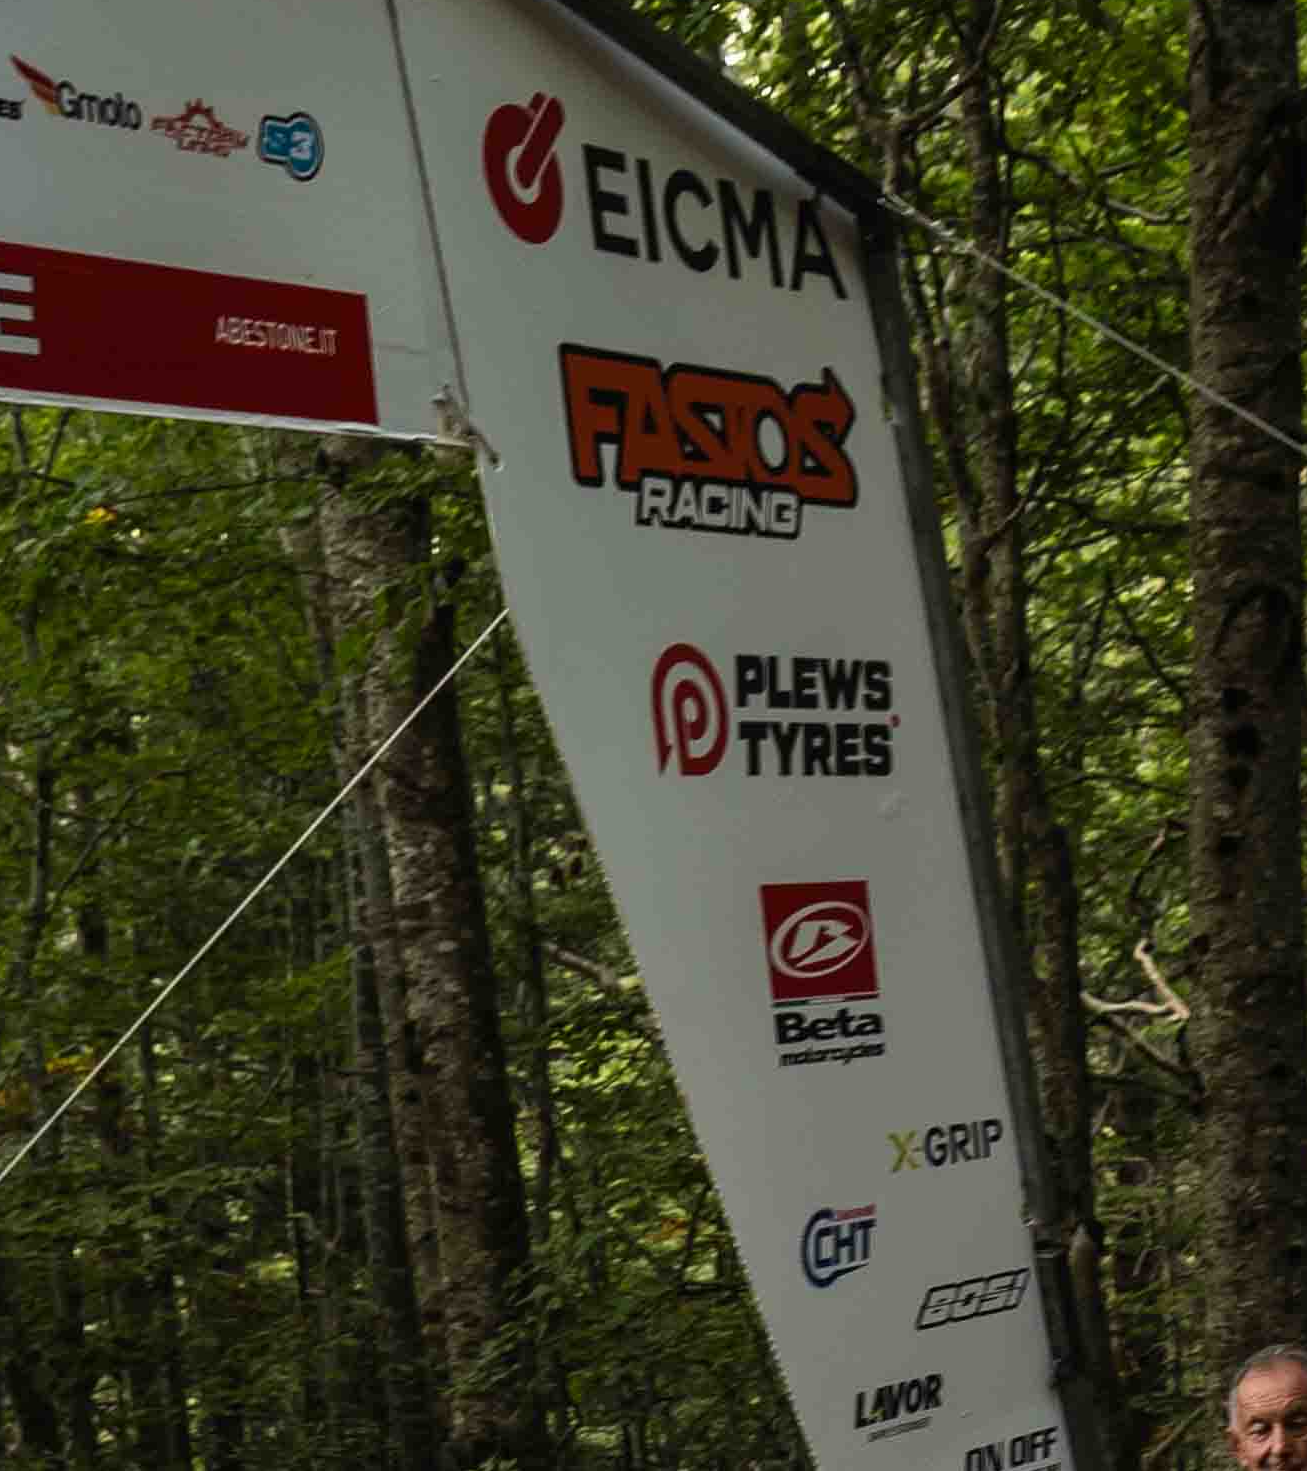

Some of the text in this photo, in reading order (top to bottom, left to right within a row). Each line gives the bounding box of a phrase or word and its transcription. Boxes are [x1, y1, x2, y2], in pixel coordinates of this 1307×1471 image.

[53, 79, 141, 131] Gmoto
[582, 142, 849, 300] EICMA
[214, 315, 338, 356] ABESTONE.IT
[635, 474, 804, 541] RACING
[734, 653, 893, 712] PLEWS
[737, 720, 893, 778] TYRES
[773, 1007, 884, 1045] Beta
[887, 1118, 1004, 1174] X-GRIP
[853, 1373, 944, 1430] LAVOR
[1010, 1425, 1060, 1467] OFF
